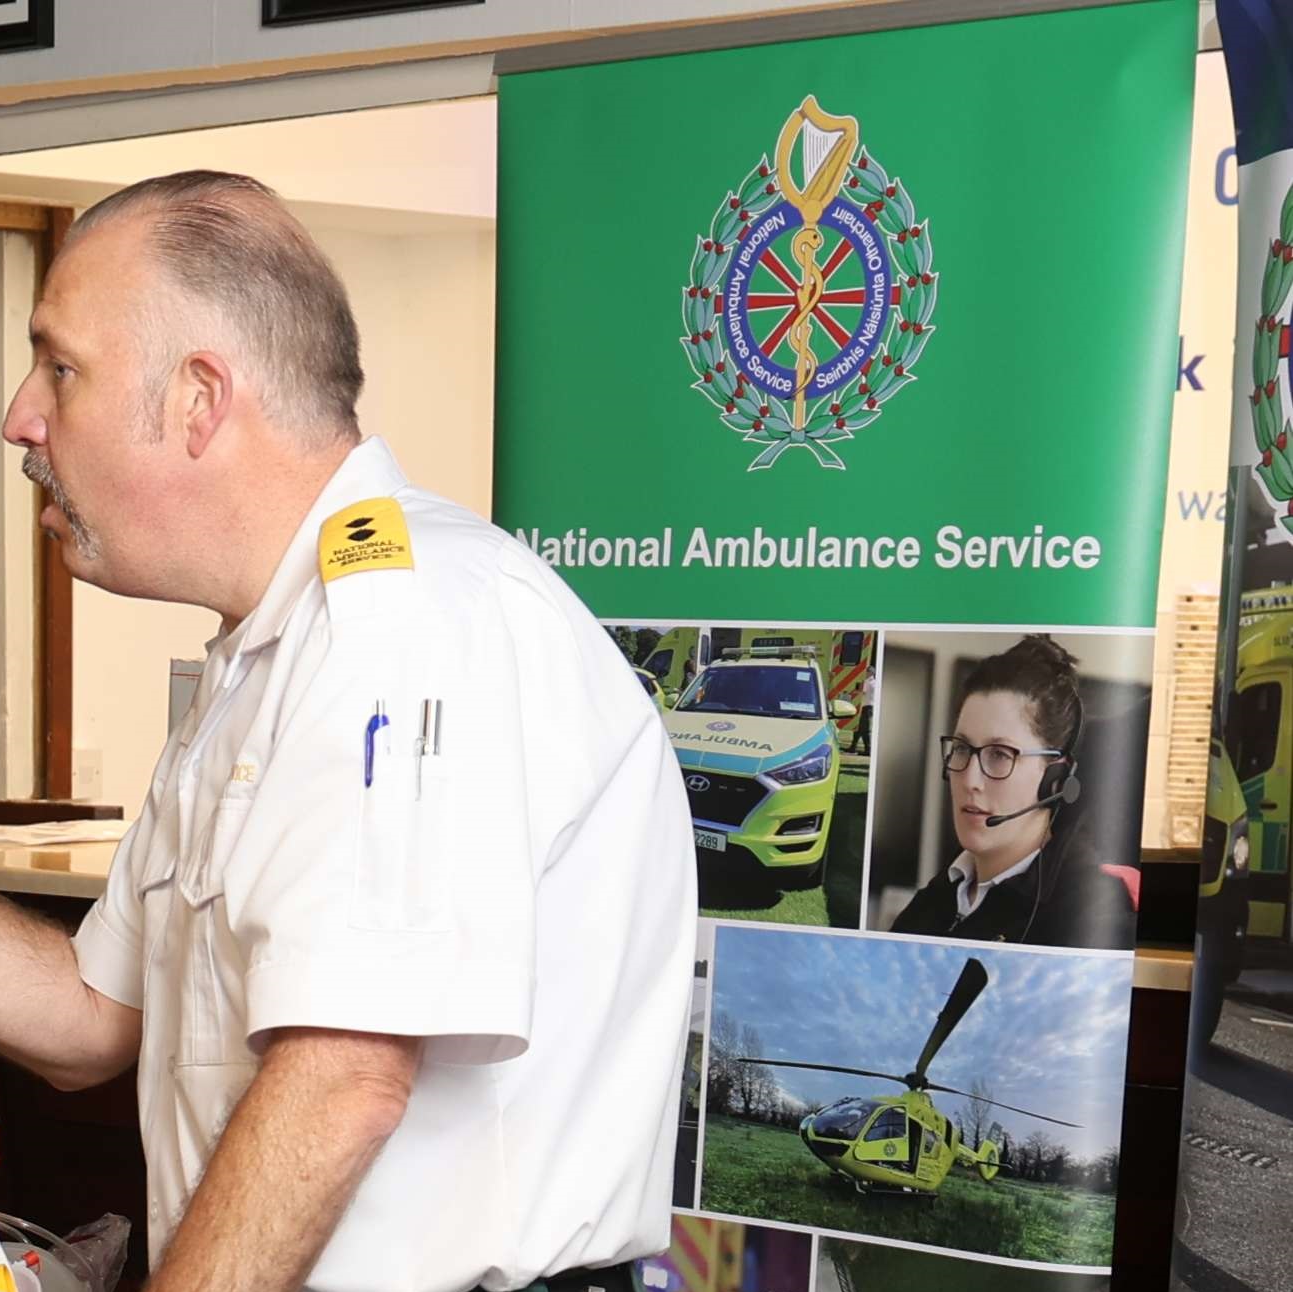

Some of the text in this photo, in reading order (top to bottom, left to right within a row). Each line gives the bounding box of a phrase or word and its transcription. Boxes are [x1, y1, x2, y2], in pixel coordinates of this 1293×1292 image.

[728, 209, 792, 392] National Ambulance Service
[327, 546, 405, 565] AMBULANCE
[333, 539, 396, 556] NATIONAL
[516, 525, 1100, 570] National Ambulance Service
